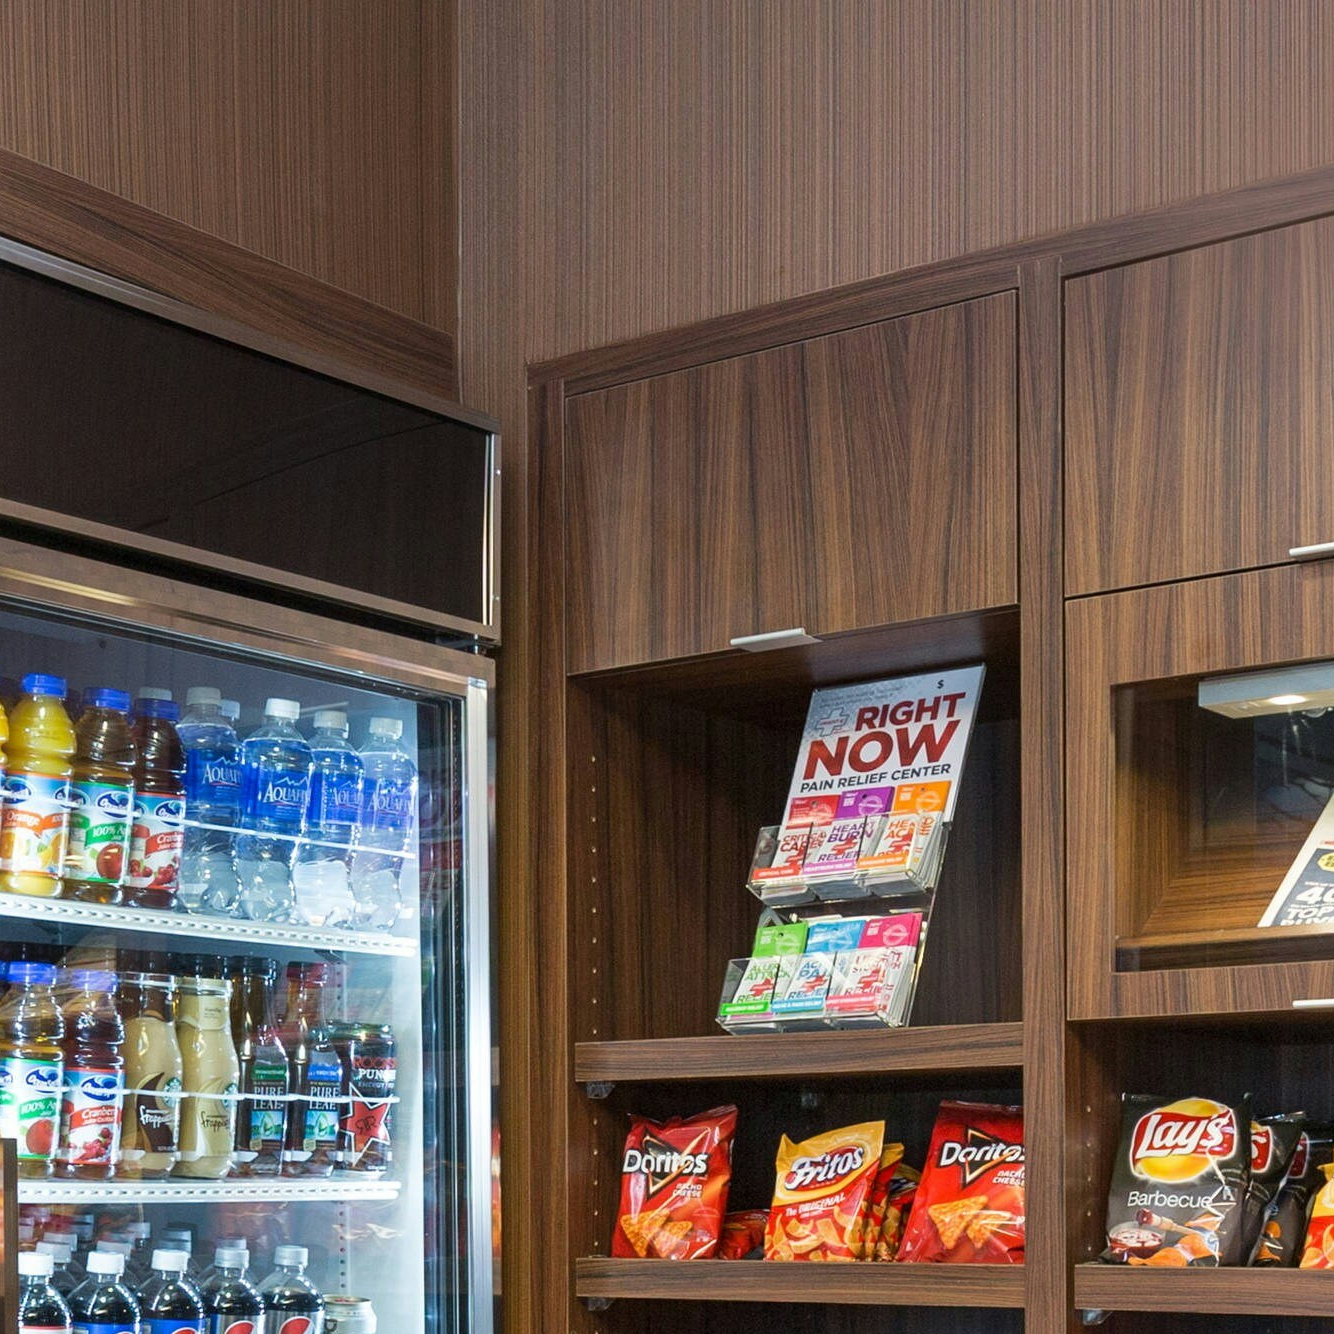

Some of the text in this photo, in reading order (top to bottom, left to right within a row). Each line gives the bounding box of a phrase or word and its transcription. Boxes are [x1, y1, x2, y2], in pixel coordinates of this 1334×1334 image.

[855, 692, 966, 731] RIGHT
[803, 719, 961, 780] NOW
[800, 763, 951, 793] PAIN RELIEF CENTER
[7, 813, 40, 826] Orange
[92, 827, 115, 838] 100%
[1287, 907, 1334, 919] TOP
[254, 1087, 284, 1097] PURE
[310, 1087, 340, 1097] PURE
[21, 1101, 46, 1114] 100%
[1136, 1113, 1230, 1159] Lay's
[622, 1150, 708, 1174] Doritos
[784, 1146, 864, 1190] Fritos
[786, 1193, 845, 1216] The ORIGINAL
[1127, 1191, 1212, 1209] Barbecue
